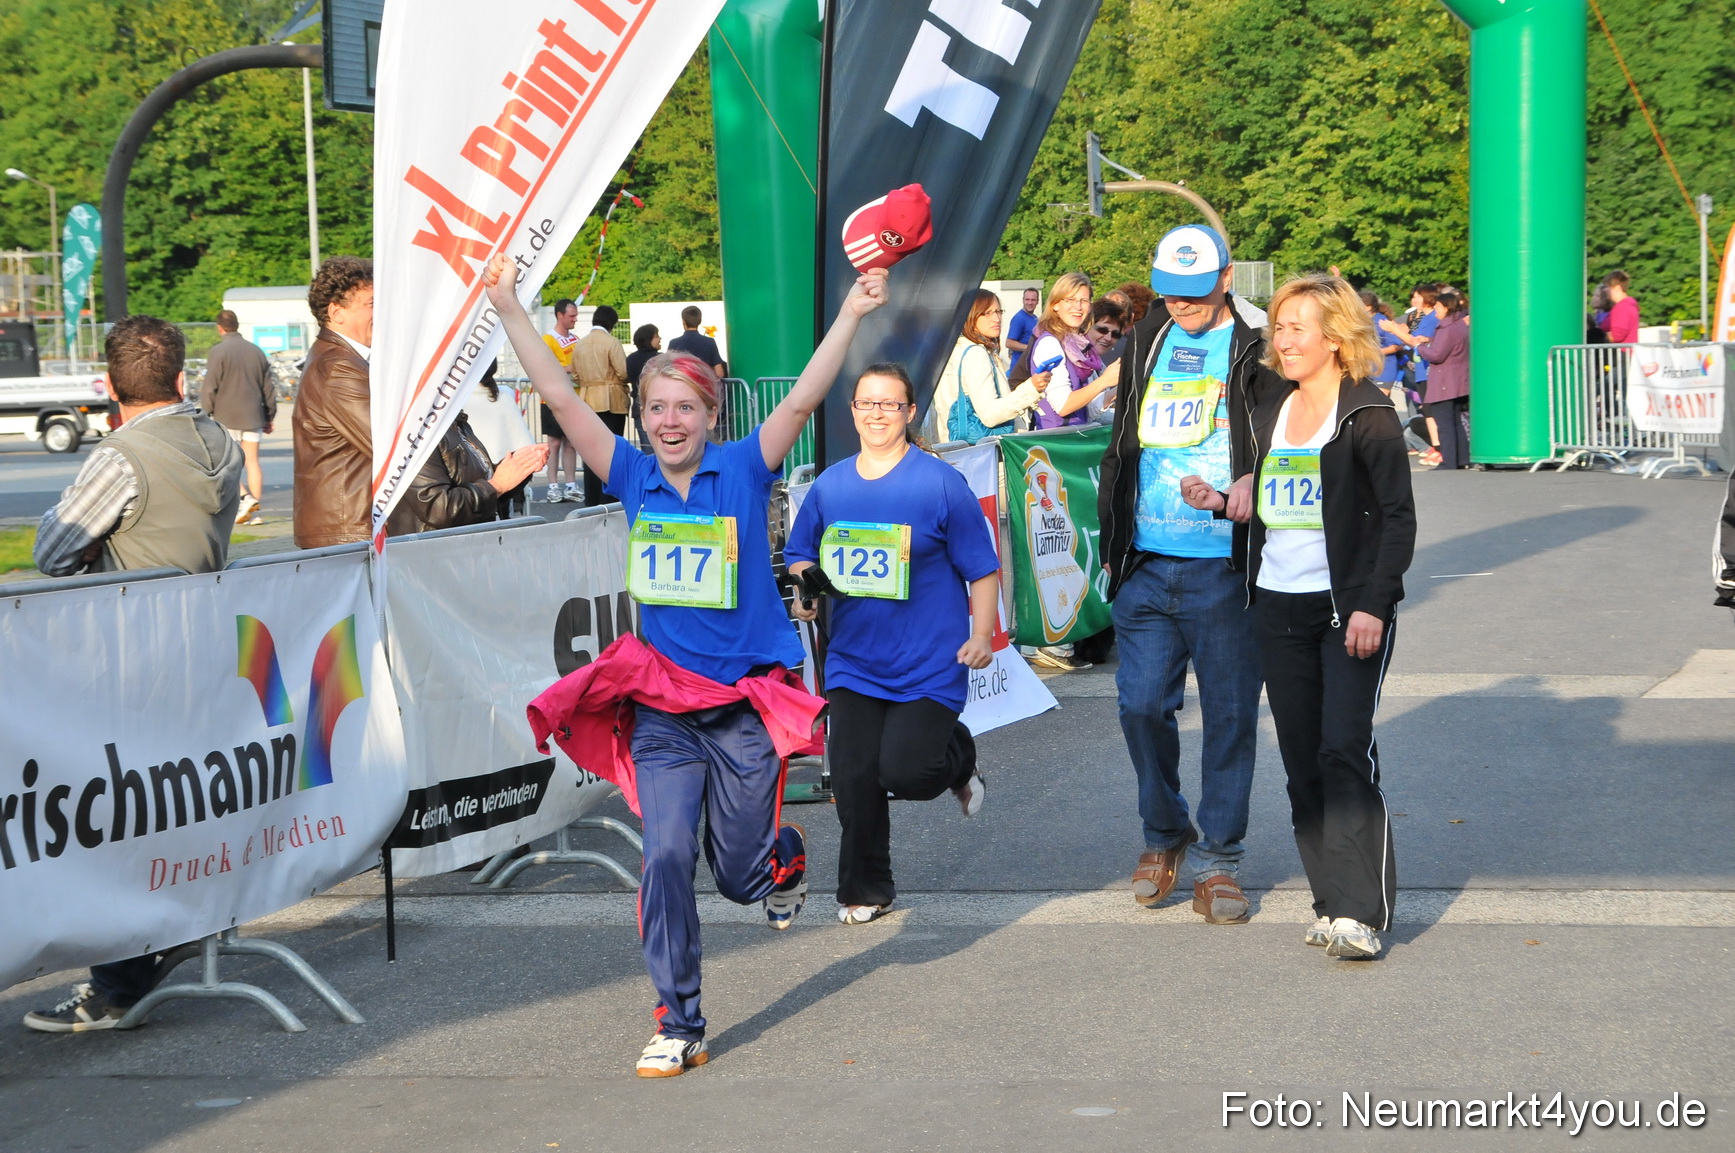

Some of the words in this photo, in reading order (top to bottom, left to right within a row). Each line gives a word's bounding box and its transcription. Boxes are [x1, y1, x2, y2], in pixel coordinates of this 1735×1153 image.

[404, 165, 511, 288] XL
[460, 18, 608, 198] Print
[1146, 398, 1204, 428] 1120
[1274, 508, 1305, 517] Gabriele
[640, 544, 713, 583] 117
[831, 546, 889, 579] 123
[651, 582, 686, 592] Barbara
[454, 796, 477, 819] die
[482, 782, 538, 815] verbinden
[148, 842, 232, 892] Druck
[242, 835, 253, 867] &
[260, 815, 347, 860] Medien
